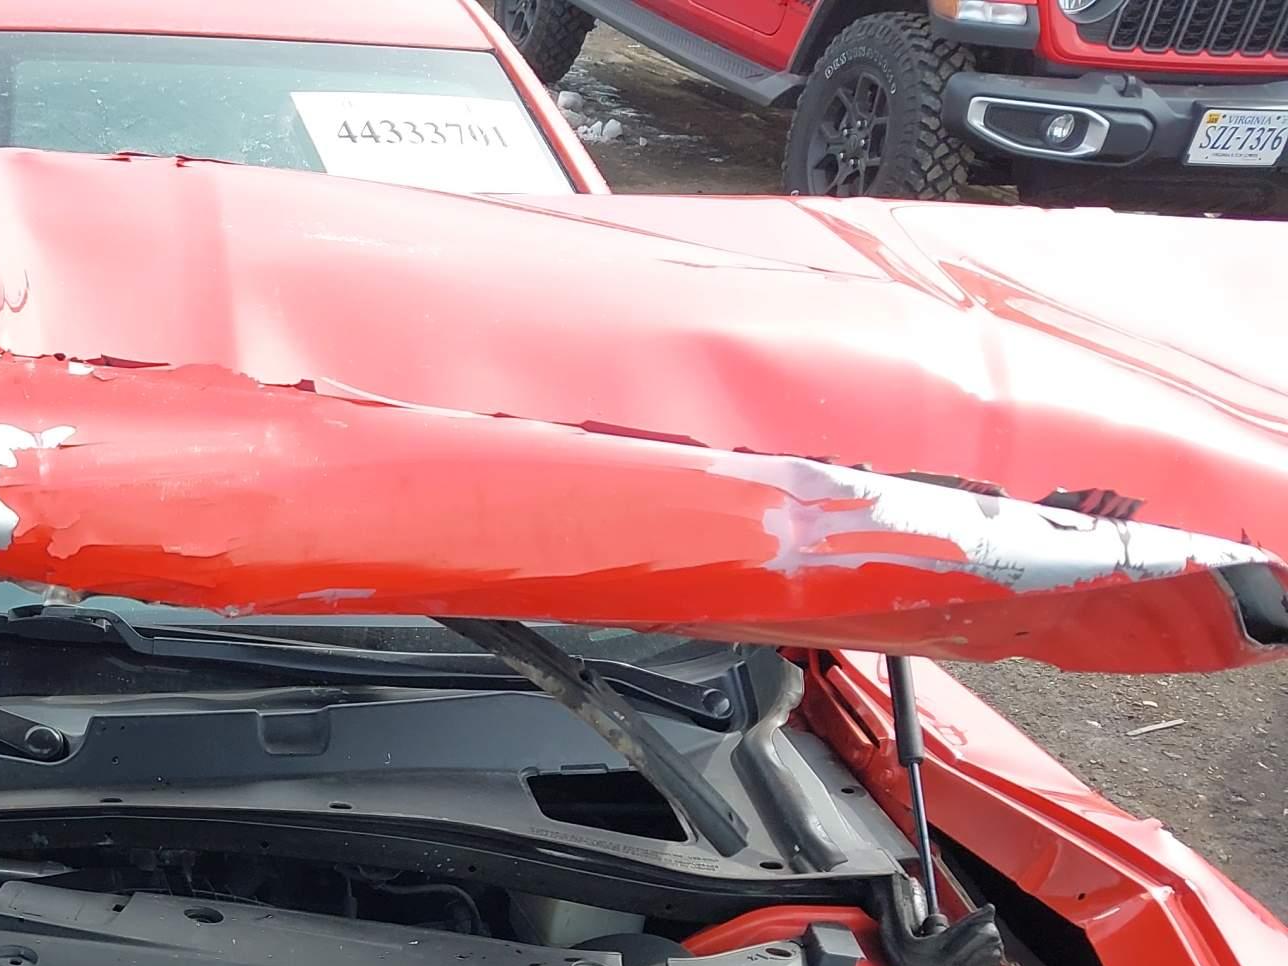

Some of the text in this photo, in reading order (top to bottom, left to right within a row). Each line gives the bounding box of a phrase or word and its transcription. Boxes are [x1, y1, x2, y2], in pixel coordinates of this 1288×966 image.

[1228, 115, 1272, 125] VIRGINIA
[336, 119, 509, 148] 44333701
[1199, 126, 1288, 151] SZZ-7376
